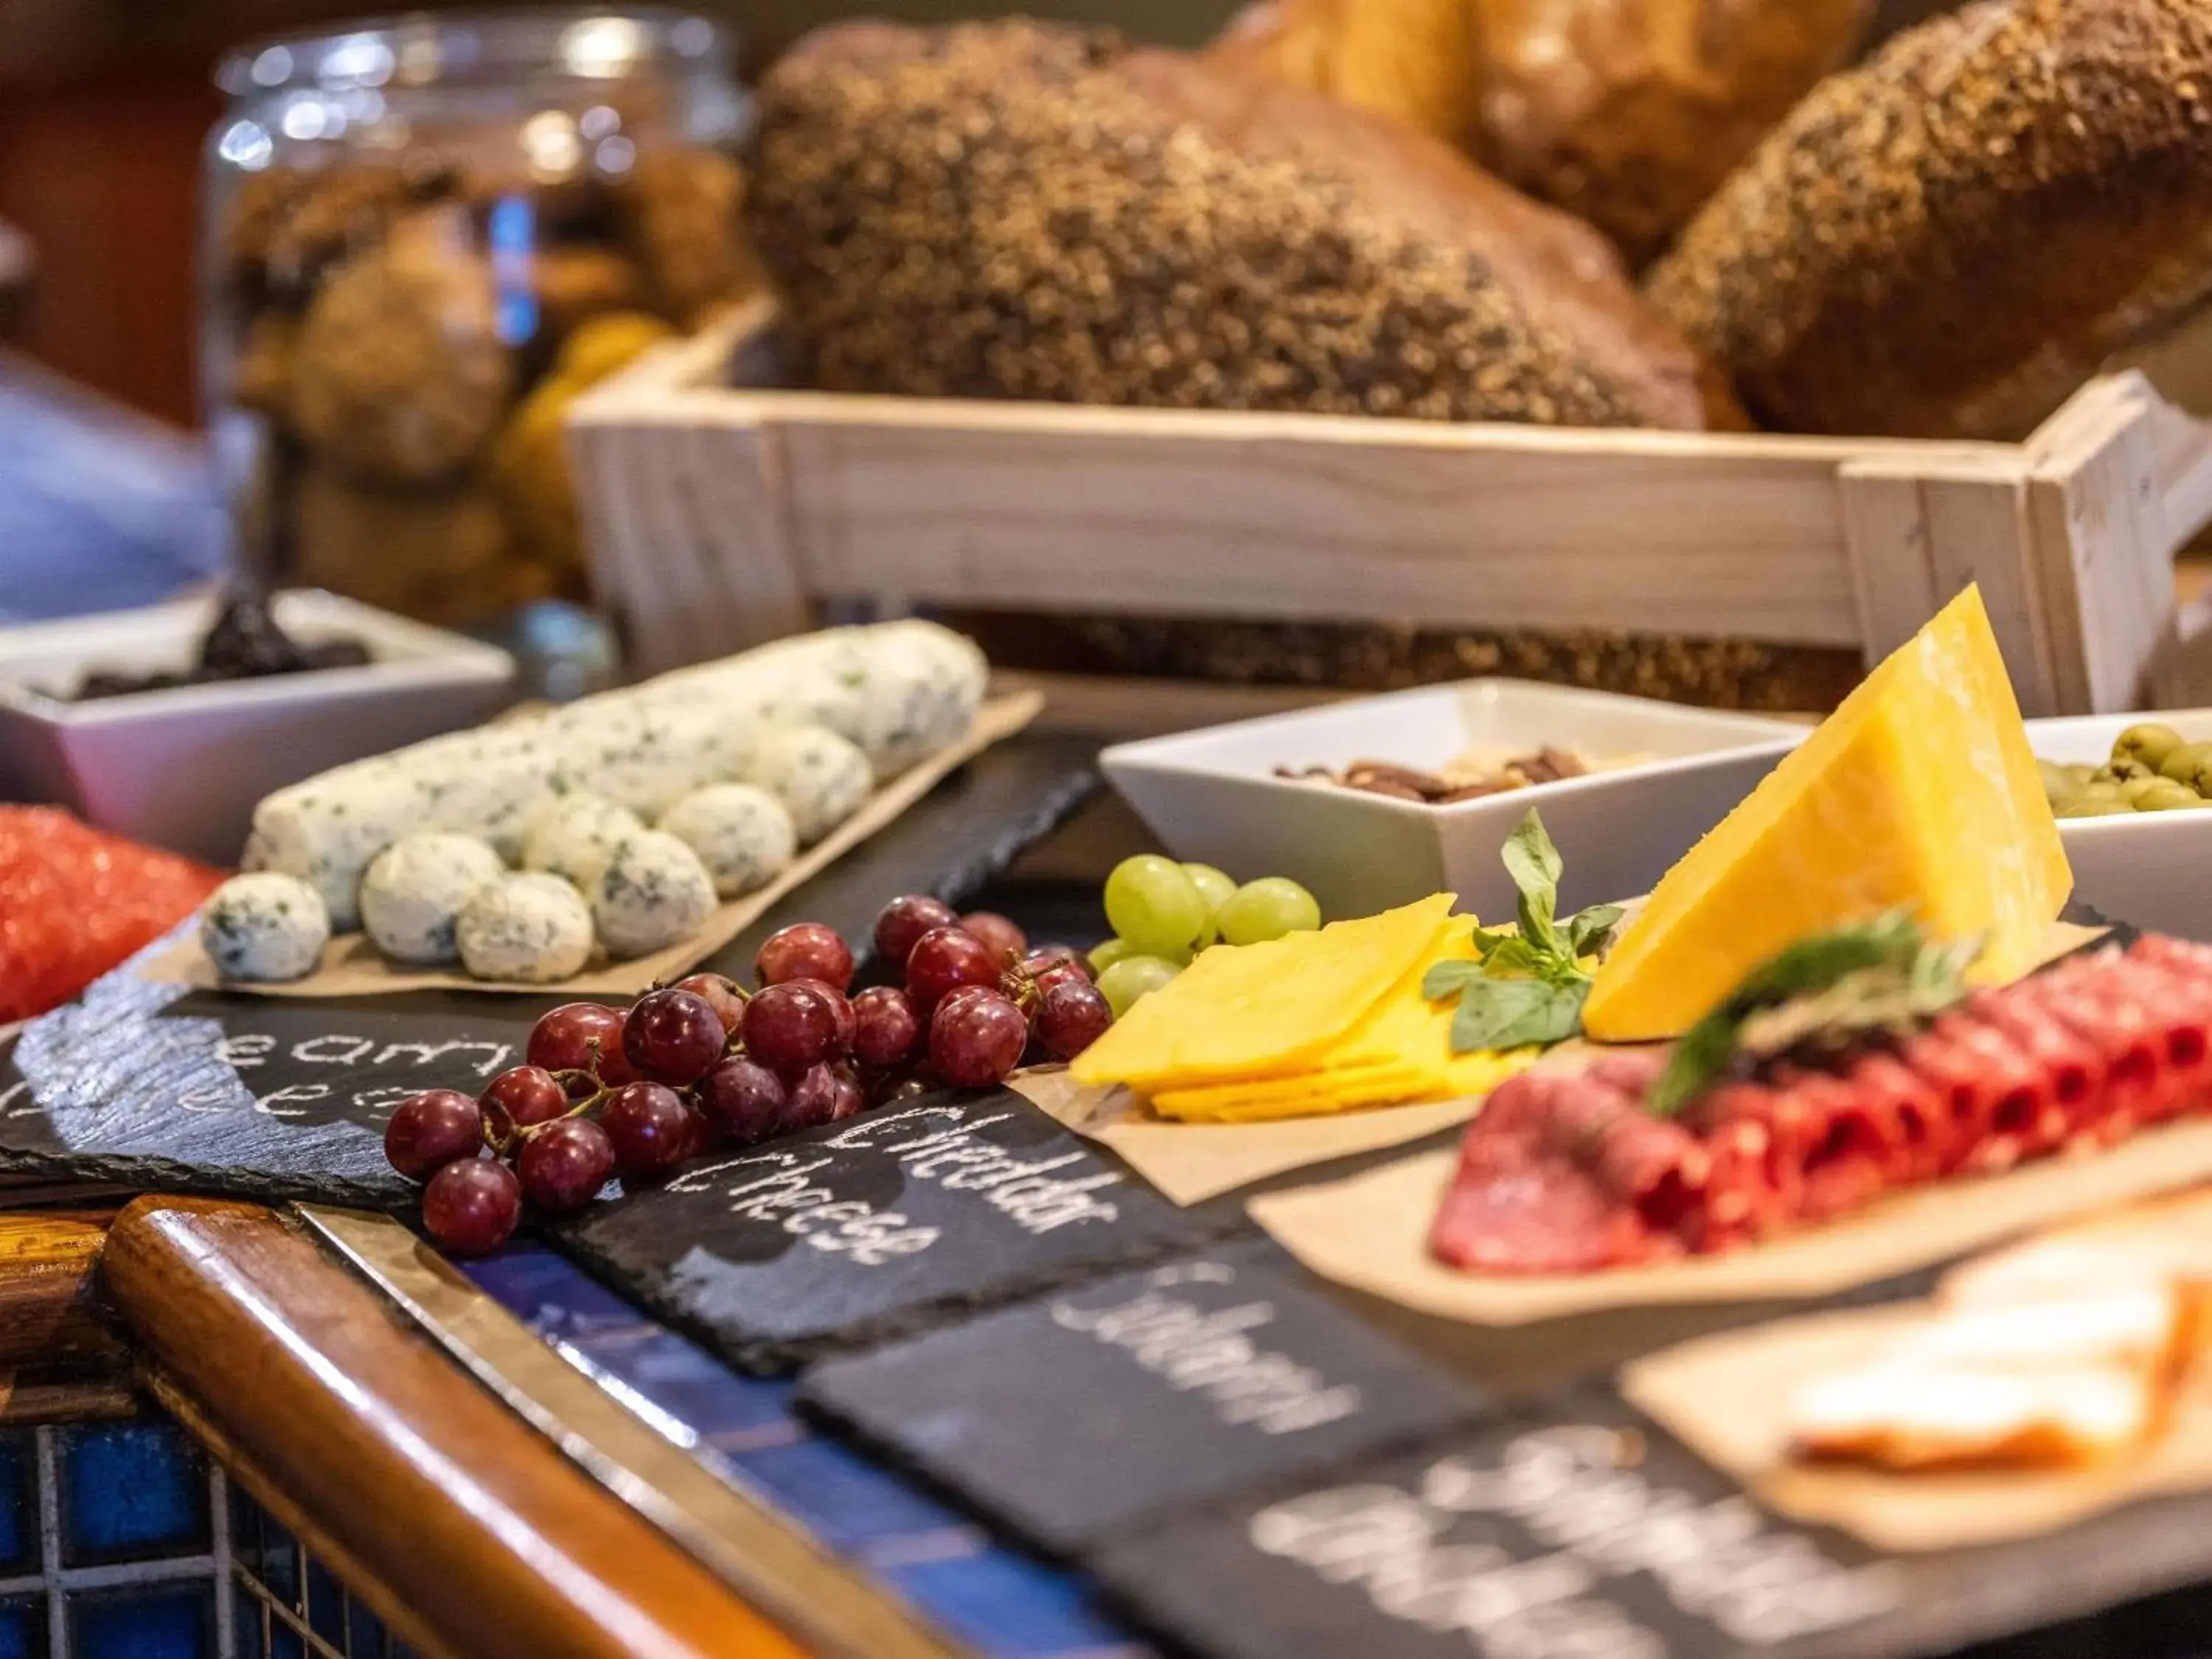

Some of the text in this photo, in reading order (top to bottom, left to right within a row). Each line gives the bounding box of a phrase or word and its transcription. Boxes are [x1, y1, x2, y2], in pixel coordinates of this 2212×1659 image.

[145, 1033, 514, 1077] eam
[664, 1152, 943, 1266] Cheese
[824, 1105, 1125, 1235] Cheddar
